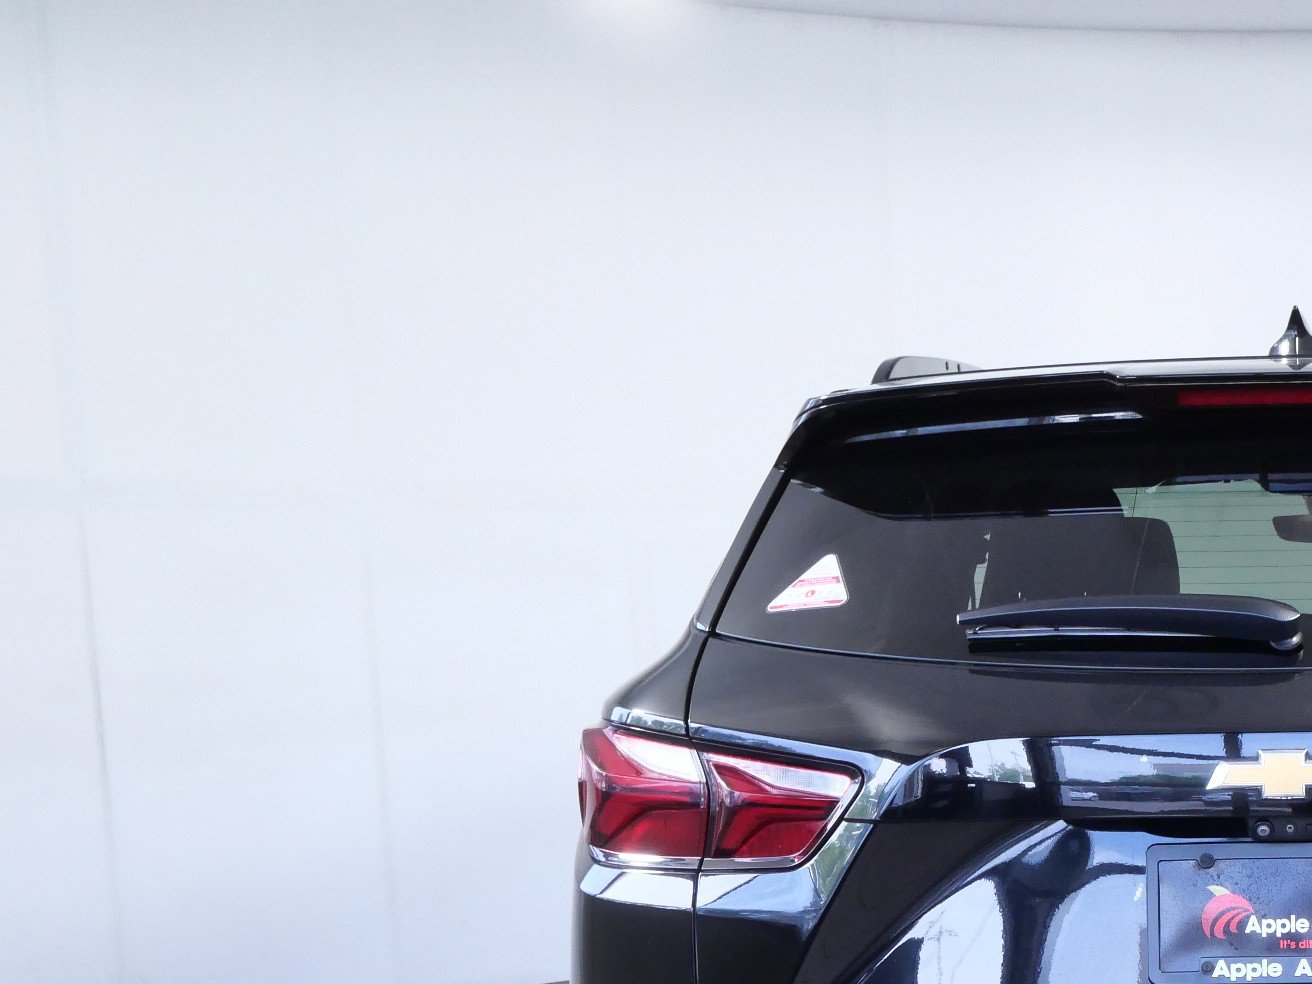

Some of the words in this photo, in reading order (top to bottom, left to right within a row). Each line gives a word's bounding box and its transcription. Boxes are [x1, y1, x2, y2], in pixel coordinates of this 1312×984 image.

[1245, 914, 1310, 937] Apple
[1279, 939, 1297, 949] It's
[1211, 958, 1283, 981] Apple
